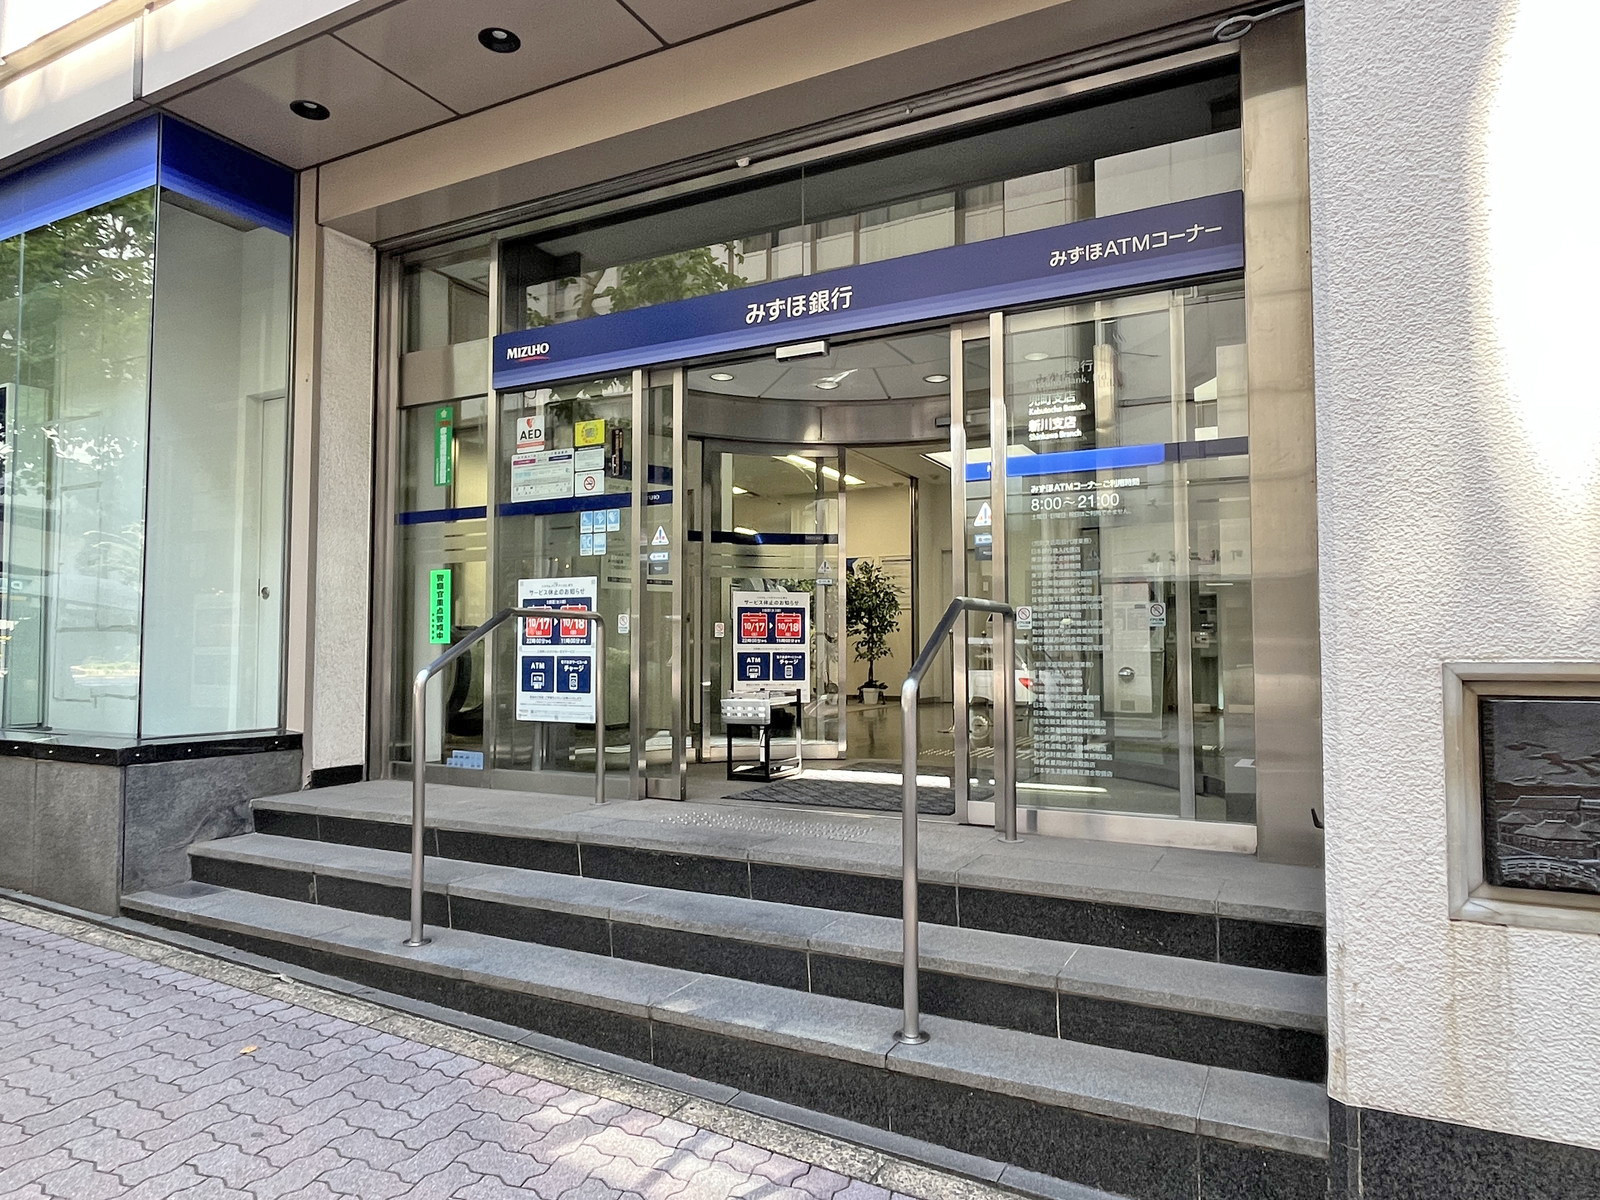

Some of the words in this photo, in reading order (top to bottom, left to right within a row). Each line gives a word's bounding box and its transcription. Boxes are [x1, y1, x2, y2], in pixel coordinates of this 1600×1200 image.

[1049, 223, 1223, 267] みずほATMコーナー
[745, 285, 853, 325] みずほ銀行
[506, 342, 550, 360] MIZUHO
[520, 428, 542, 441] AED
[529, 617, 551, 630] 10/17
[744, 622, 766, 632] 10/17
[778, 622, 799, 632] 10/18
[530, 662, 546, 670] ATM
